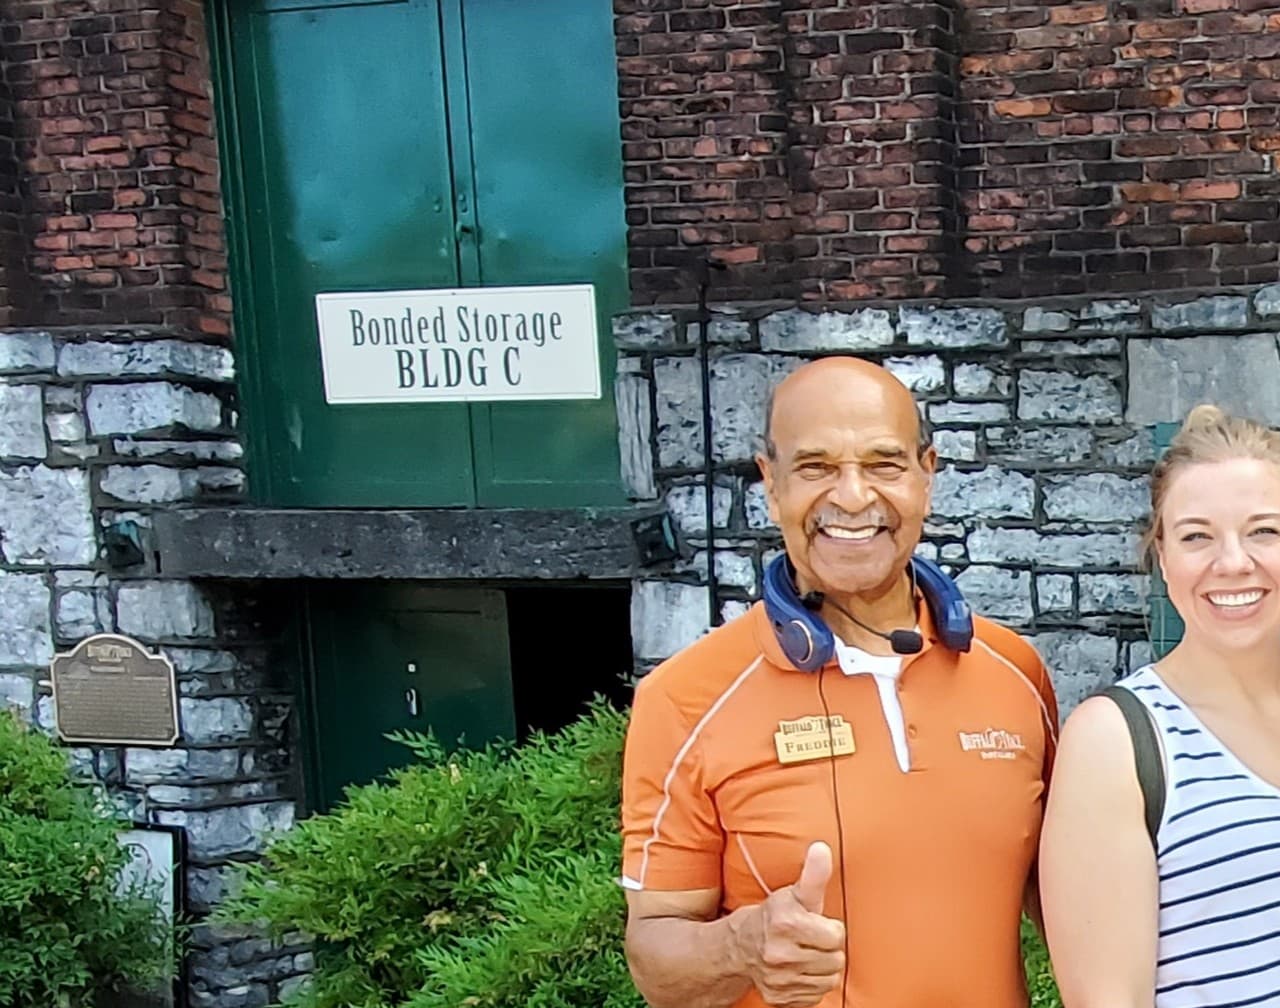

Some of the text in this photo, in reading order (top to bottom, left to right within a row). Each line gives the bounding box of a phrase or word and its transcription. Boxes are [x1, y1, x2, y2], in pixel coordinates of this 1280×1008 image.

[349, 306, 562, 346] Bonded Storage
[396, 346, 522, 388] BLDG C
